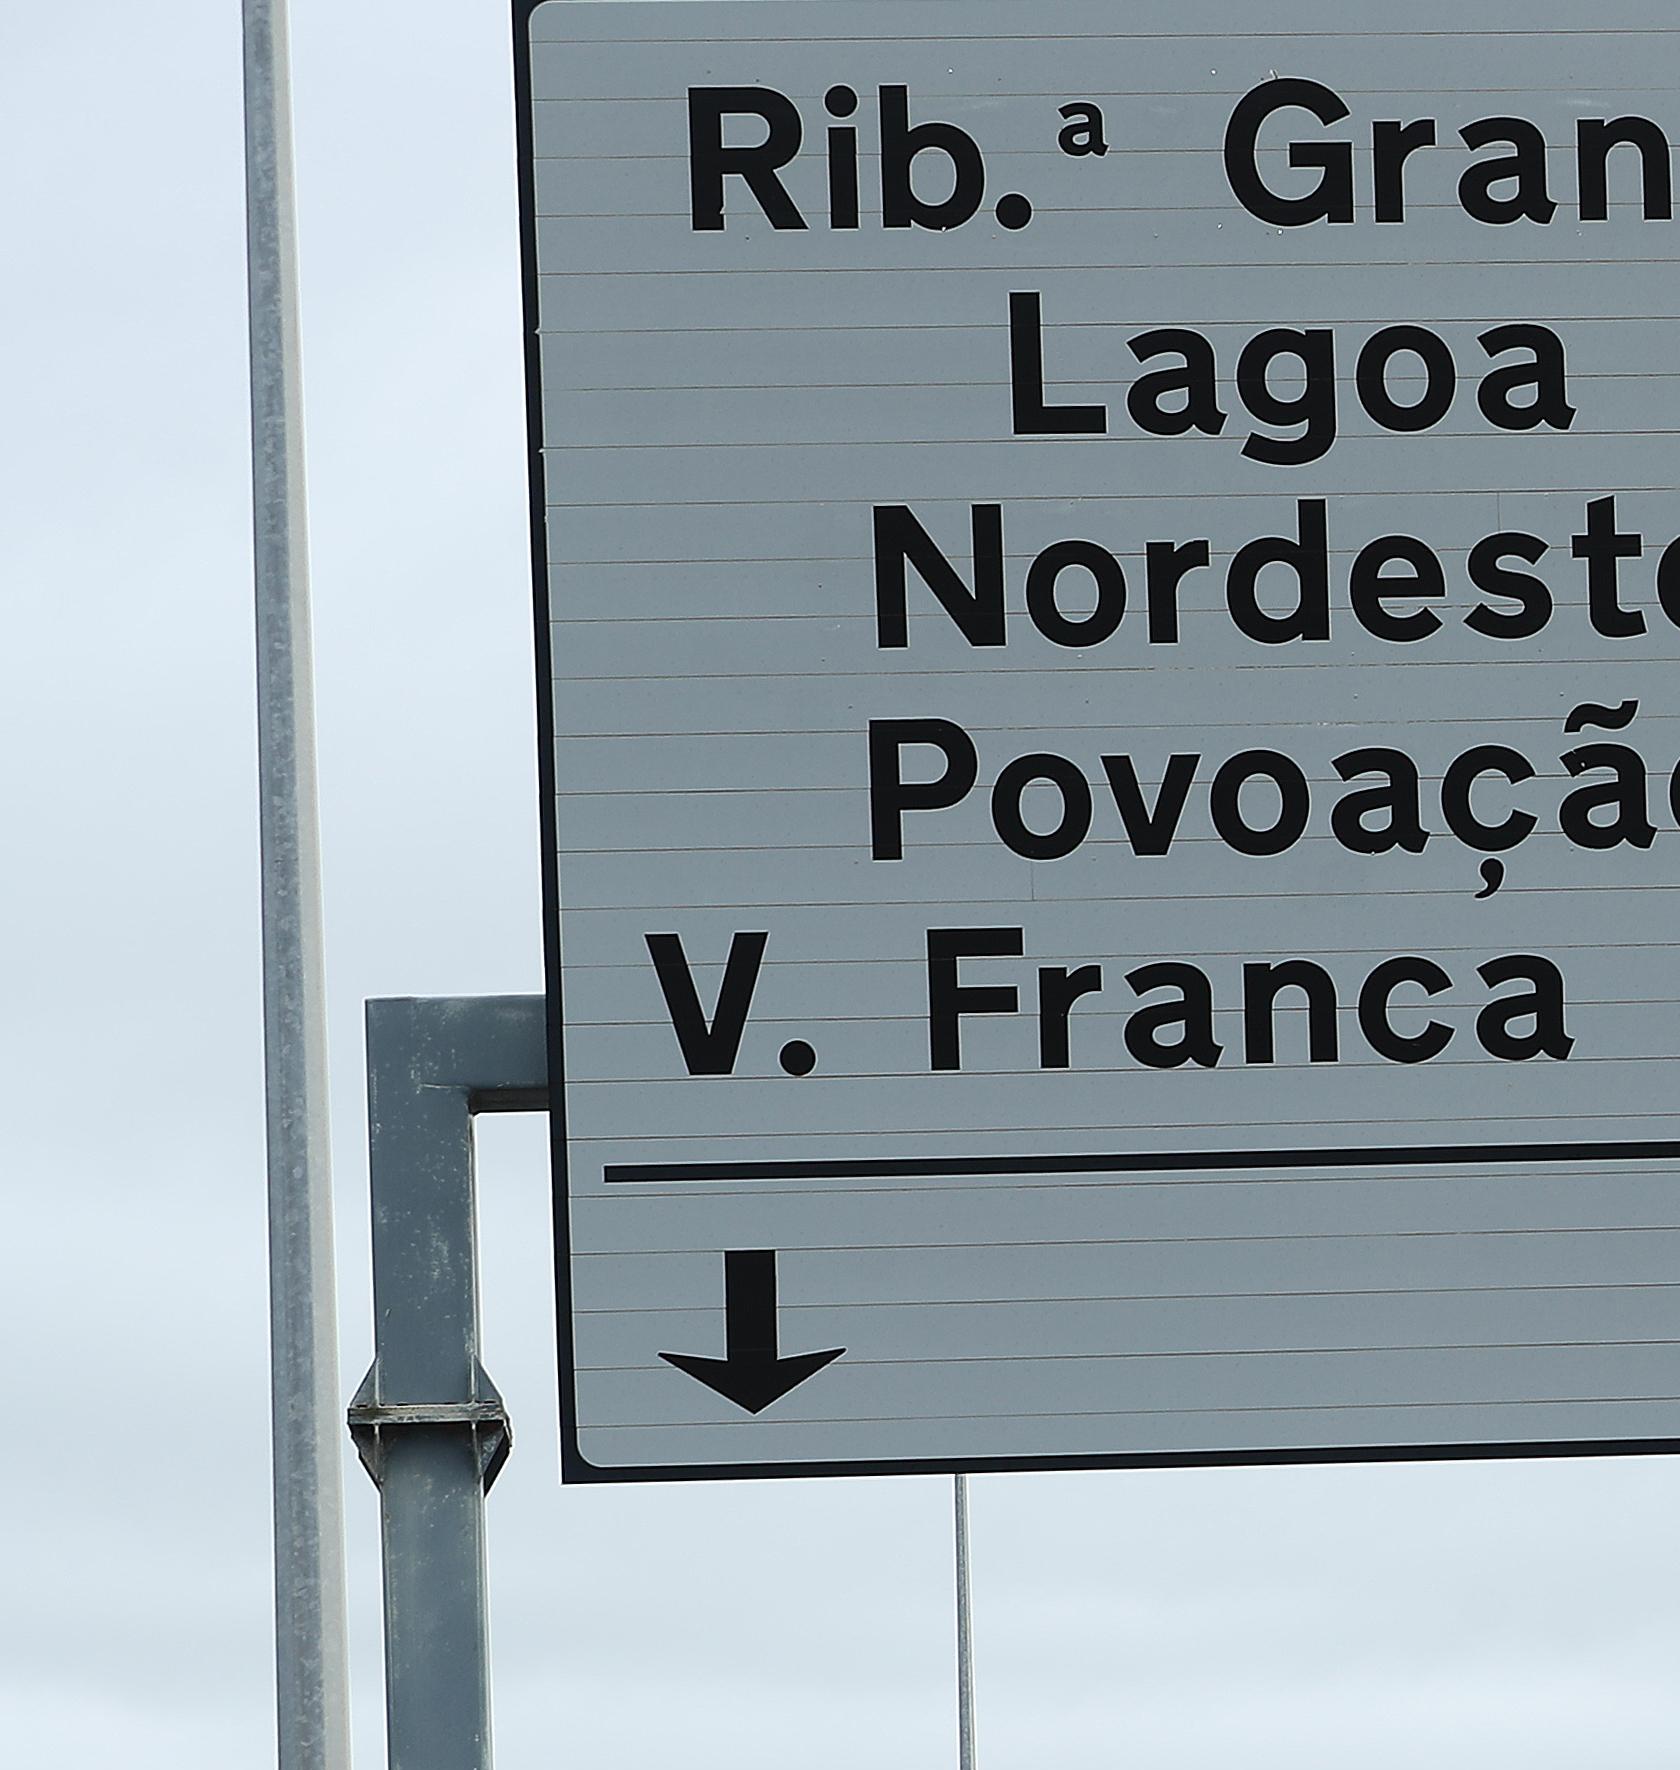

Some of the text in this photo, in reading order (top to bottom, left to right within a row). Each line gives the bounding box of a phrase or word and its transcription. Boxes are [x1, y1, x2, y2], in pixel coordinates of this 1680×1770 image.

[1009, 291, 1577, 466] Lagoa
[644, 931, 816, 1077] V.
[926, 927, 1576, 1071] Franca
